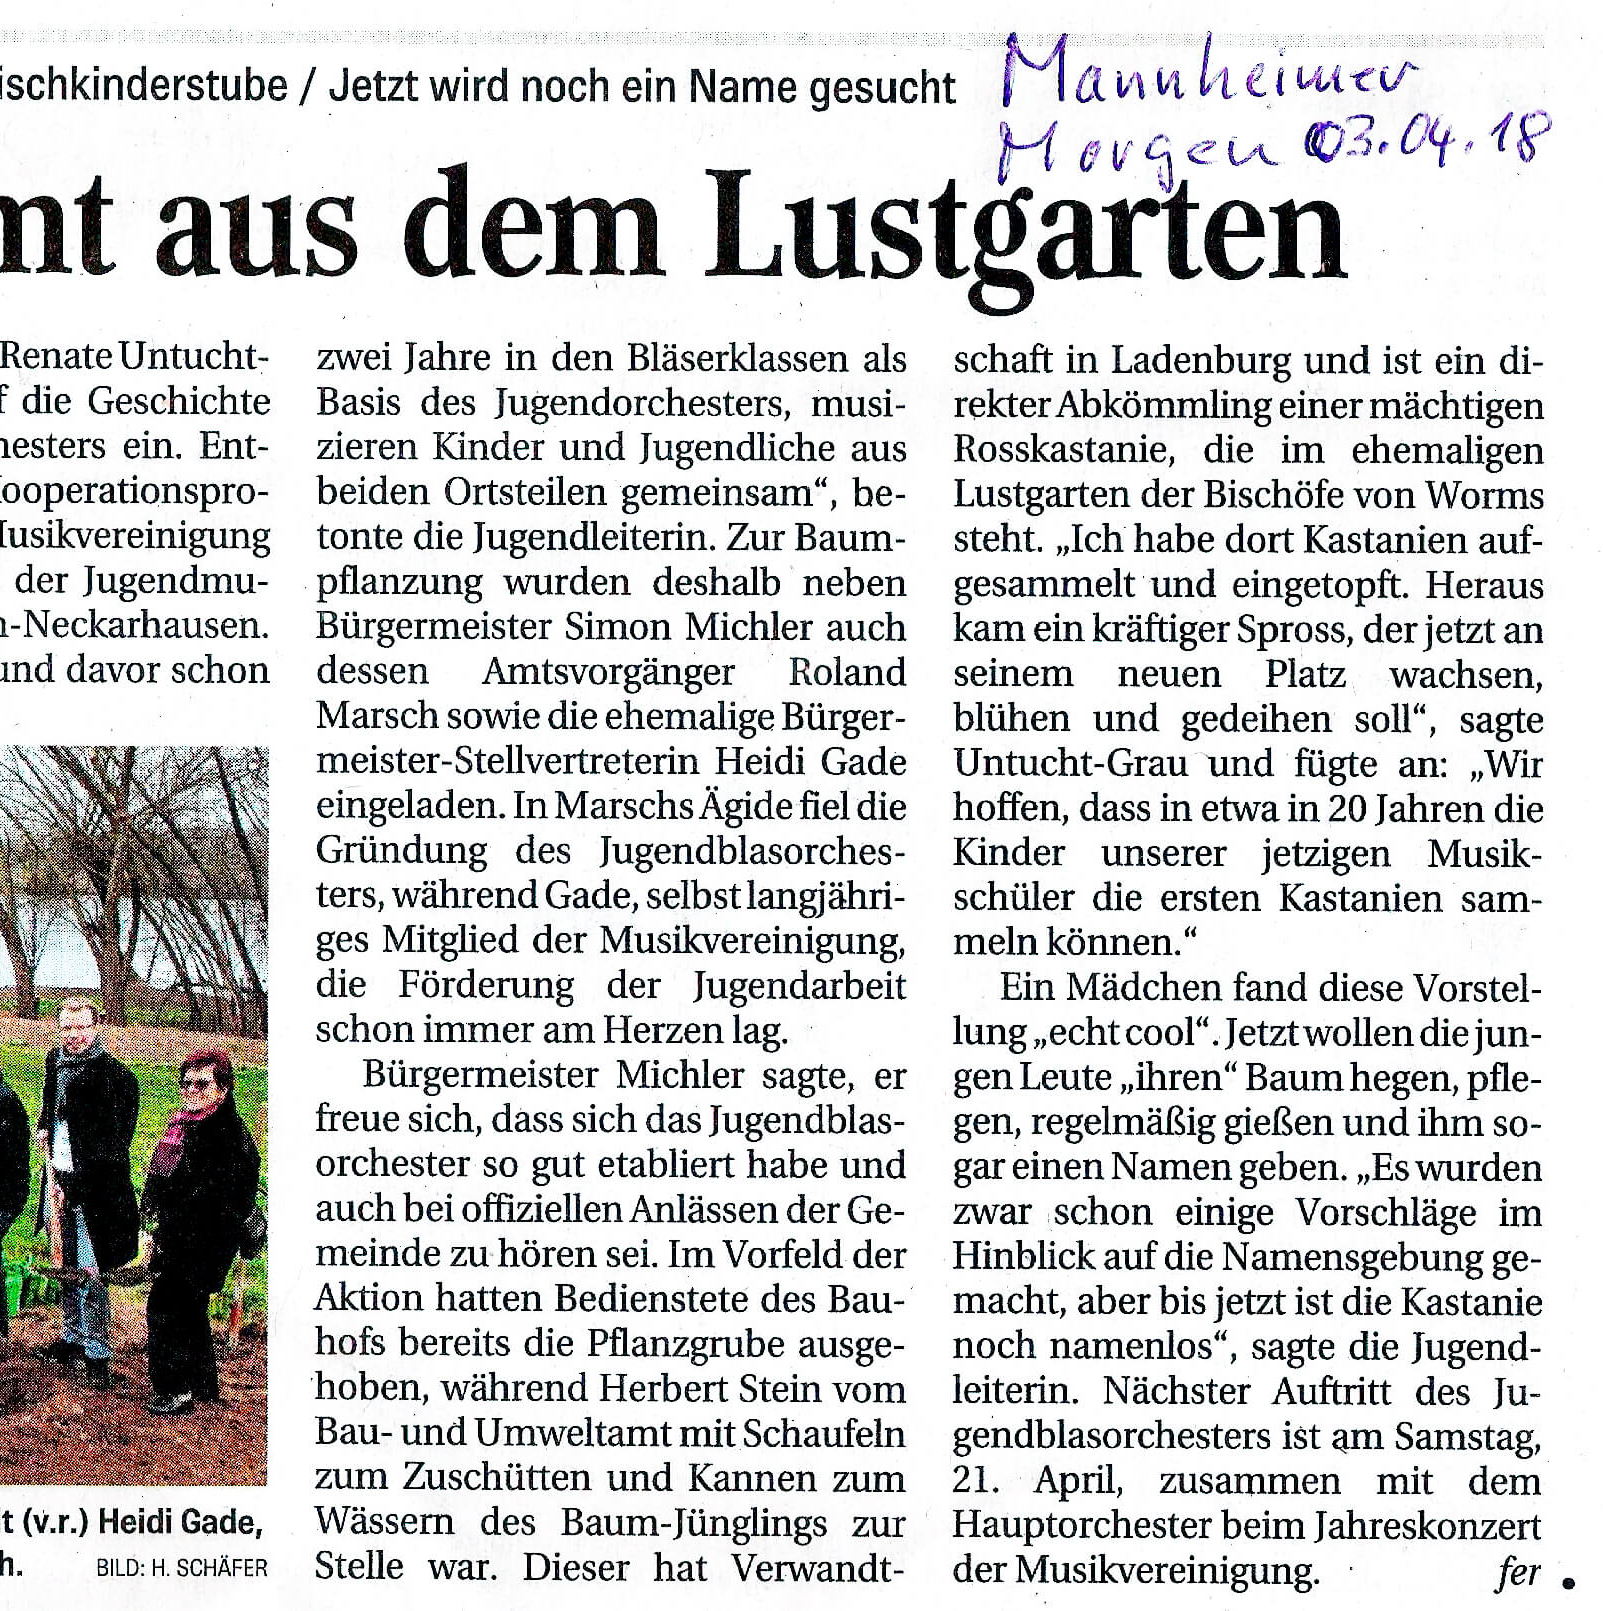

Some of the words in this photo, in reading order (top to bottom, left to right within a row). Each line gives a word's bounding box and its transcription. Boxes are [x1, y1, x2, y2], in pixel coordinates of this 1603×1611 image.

[1002, 31, 1419, 107] Mannheimer
[299, 67, 316, 106] /
[329, 68, 418, 101] Jetzt
[429, 67, 508, 101] wird
[523, 67, 608, 102] noch
[623, 68, 675, 102] ein
[691, 69, 796, 103] Name
[810, 69, 956, 112] gesucht
[997, 119, 1282, 193] Morgen
[157, 195, 357, 277] aus
[404, 162, 666, 278] dem
[705, 169, 1348, 317] Lustgarten
[317, 342, 391, 370] zwei
[404, 341, 490, 374] Jahre
[505, 342, 537, 370] in
[552, 342, 613, 371] den
[628, 342, 849, 372] Bläserklassen
[864, 343, 906, 372] als
[954, 433, 1174, 467] Rosskastanie,
[1204, 434, 1253, 463] die
[1282, 435, 1325, 463] im
[1353, 434, 1544, 473] ehemaligen
[316, 611, 552, 648] Bürgermeister
[566, 611, 671, 640] Simon
[685, 611, 813, 640] Michler
[827, 612, 907, 641] auch
[67, 653, 160, 683] davor
[172, 654, 270, 683] schon
[953, 701, 1070, 731] blühen
[1093, 702, 1159, 731] und
[1182, 703, 1333, 741] gedeihen
[1461, 708, 1543, 742] sagte
[317, 834, 487, 872] Gründung
[516, 834, 570, 864] des
[600, 835, 905, 873] Jugendblasorches-
[1001, 972, 1055, 1000] Ein
[1067, 971, 1223, 1001] Mädchen
[1233, 971, 1307, 1001] fand
[1320, 972, 1403, 1002] diese
[1413, 973, 1541, 1002] Vorstel-
[953, 1204, 1032, 1225] zwar
[1055, 1195, 1153, 1225] schon
[1176, 1197, 1273, 1234] einige
[1295, 1196, 1476, 1235] Vorschläge
[1499, 1198, 1542, 1227] im
[315, 1326, 385, 1355] hofs
[398, 1326, 510, 1356] bereits
[525, 1327, 573, 1356] die
[588, 1327, 784, 1366] Pflanzgrube
[799, 1337, 904, 1367] ausge-
[953, 1465, 998, 1493] 21.
[1033, 1464, 1122, 1502] April,
[1160, 1473, 1341, 1496] zusammen
[1377, 1466, 1434, 1495] mit
[1469, 1465, 1541, 1495] dem
[23, 1507, 88, 1537] (v.r.)
[100, 1508, 171, 1534] Heidi
[182, 1508, 262, 1539] Gade,
[98, 1558, 144, 1576] BILD:
[153, 1559, 164, 1576] H.
[177, 1555, 267, 1577] SCHÄFER
[316, 1550, 403, 1579] Stelle
[428, 1560, 496, 1580] war.
[523, 1553, 630, 1581] Dieser
[654, 1552, 707, 1581] hat
[731, 1553, 904, 1582] Verwandt-
[953, 1553, 1007, 1583] der
[1016, 1554, 1319, 1593] Musikvereinigung.
[1493, 1555, 1541, 1594] fer
